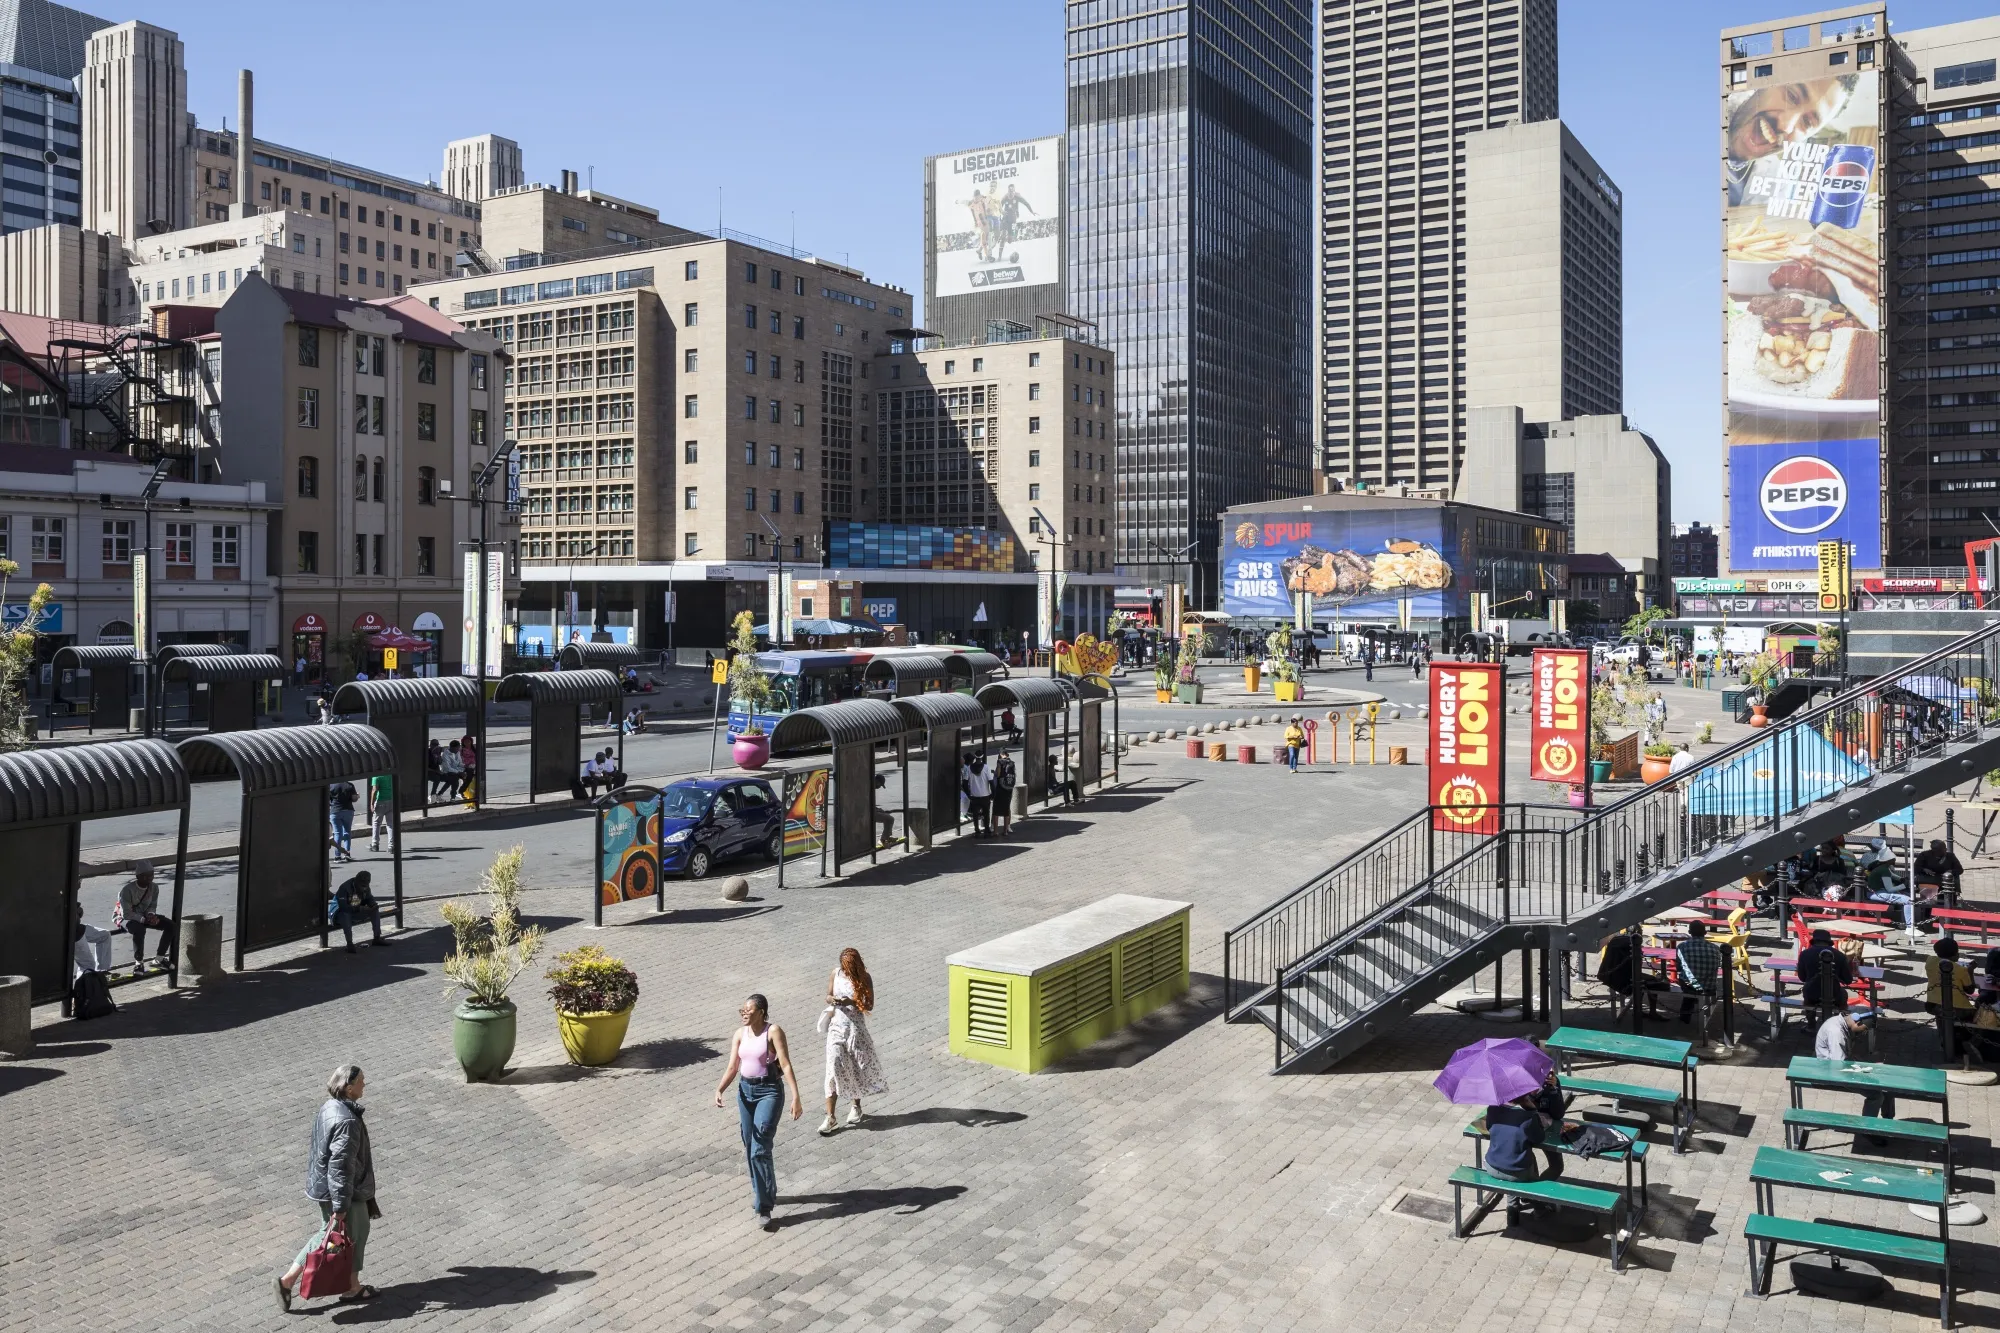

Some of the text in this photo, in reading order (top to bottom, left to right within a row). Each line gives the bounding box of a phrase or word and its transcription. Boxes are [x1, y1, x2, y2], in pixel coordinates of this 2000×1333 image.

[953, 145, 1039, 175] LISEGAZINI.
[1782, 141, 1829, 162] YOUR
[972, 166, 1020, 184] FOREVER.
[1778, 160, 1824, 184] KOTA
[1748, 175, 1820, 202] BETTER
[1821, 178, 1867, 191] PEPSI
[1766, 196, 1814, 221] WITH
[993, 270, 1019, 279] betway
[1767, 486, 1839, 503] PEPSI
[1264, 523, 1313, 547] SPUR
[488, 554, 497, 592] GANDHI
[1238, 561, 1273, 579] SA'S
[1819, 543, 1830, 593] Gandhi
[1234, 580, 1278, 597] FAVES
[1679, 581, 1732, 592] Dis-Chem
[1771, 581, 1792, 590] OPH
[1882, 579, 1937, 587] SCORPION
[870, 603, 895, 618] PEP
[1119, 611, 1137, 620] KFC
[1540, 655, 1554, 728] HUNGRY
[1555, 656, 1579, 730] LION
[1440, 670, 1457, 764] HUNGRY
[1458, 671, 1489, 766] LION
